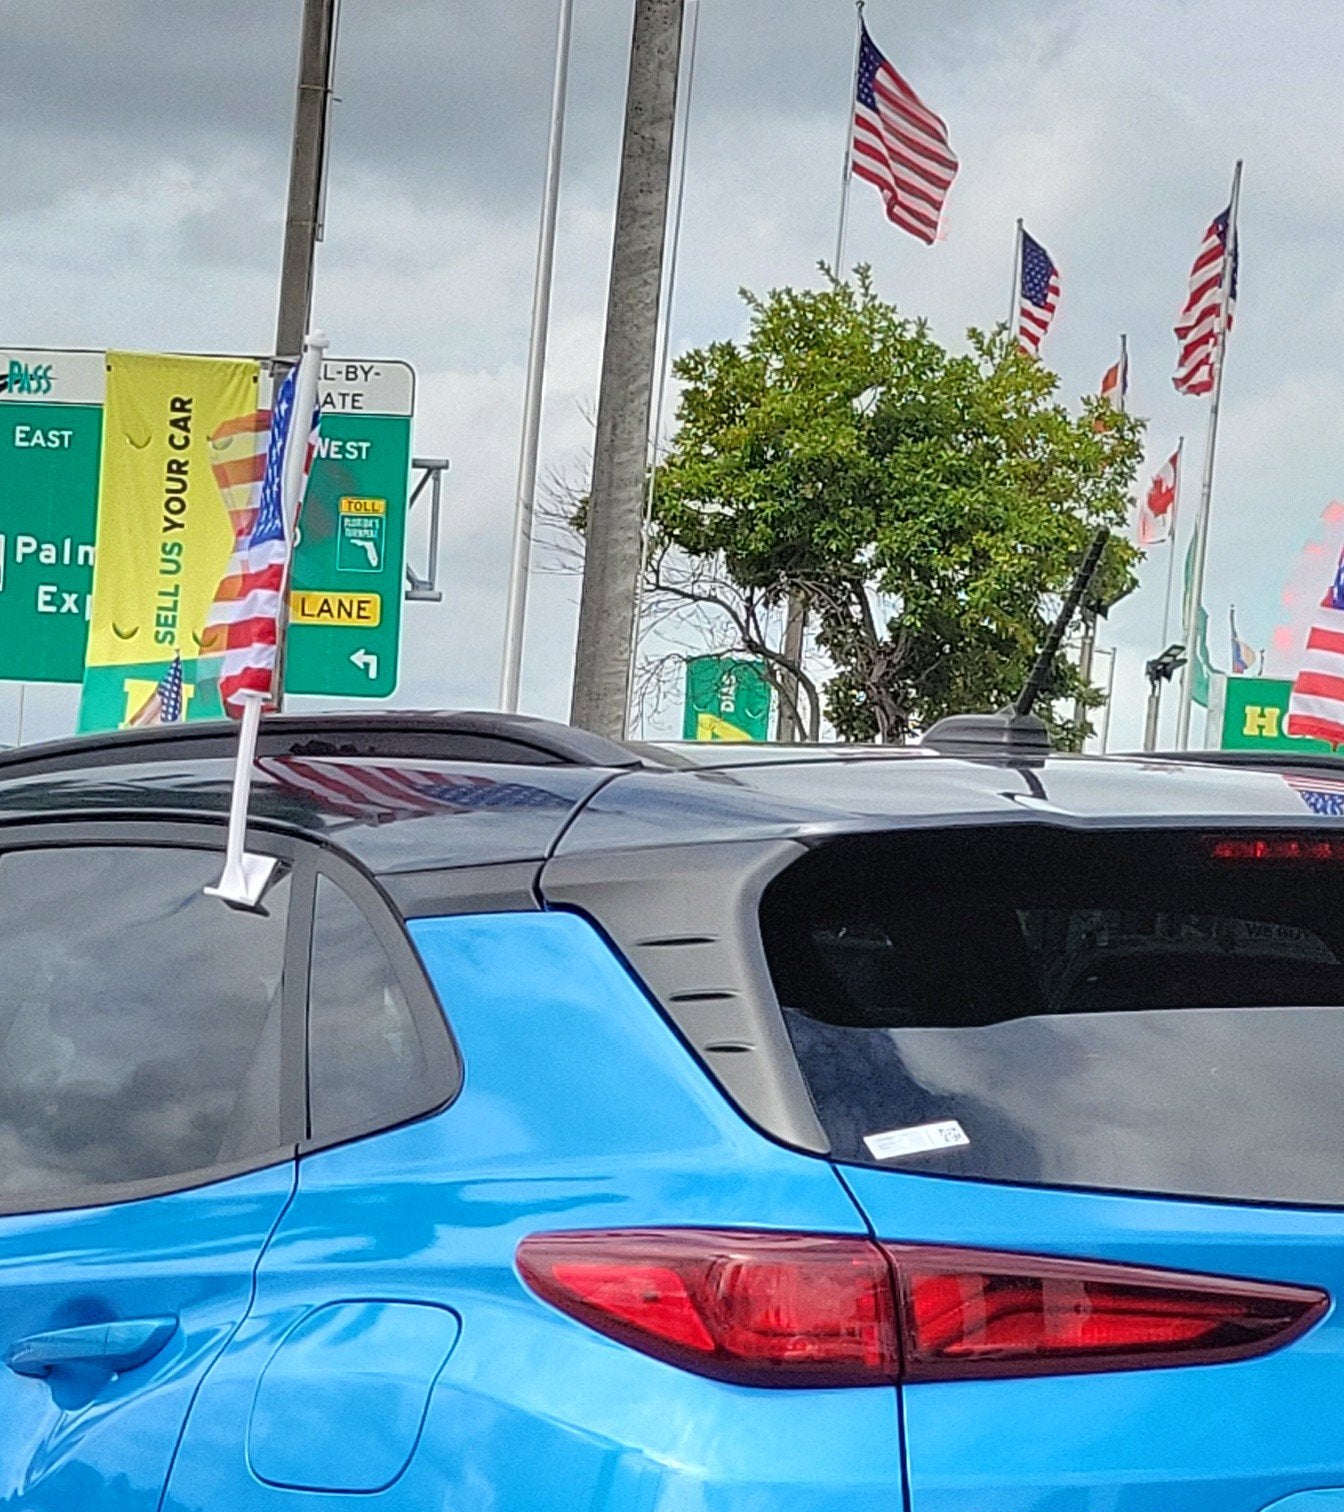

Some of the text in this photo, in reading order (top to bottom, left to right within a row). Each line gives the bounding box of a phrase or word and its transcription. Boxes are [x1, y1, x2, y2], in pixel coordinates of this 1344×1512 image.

[318, 364, 381, 382] L-BY-
[322, 391, 364, 410] ATE
[14, 425, 74, 449] EAST
[346, 500, 381, 513] TOLL
[154, 395, 193, 645] SELL US YOUR CAR
[300, 596, 372, 620] LANE
